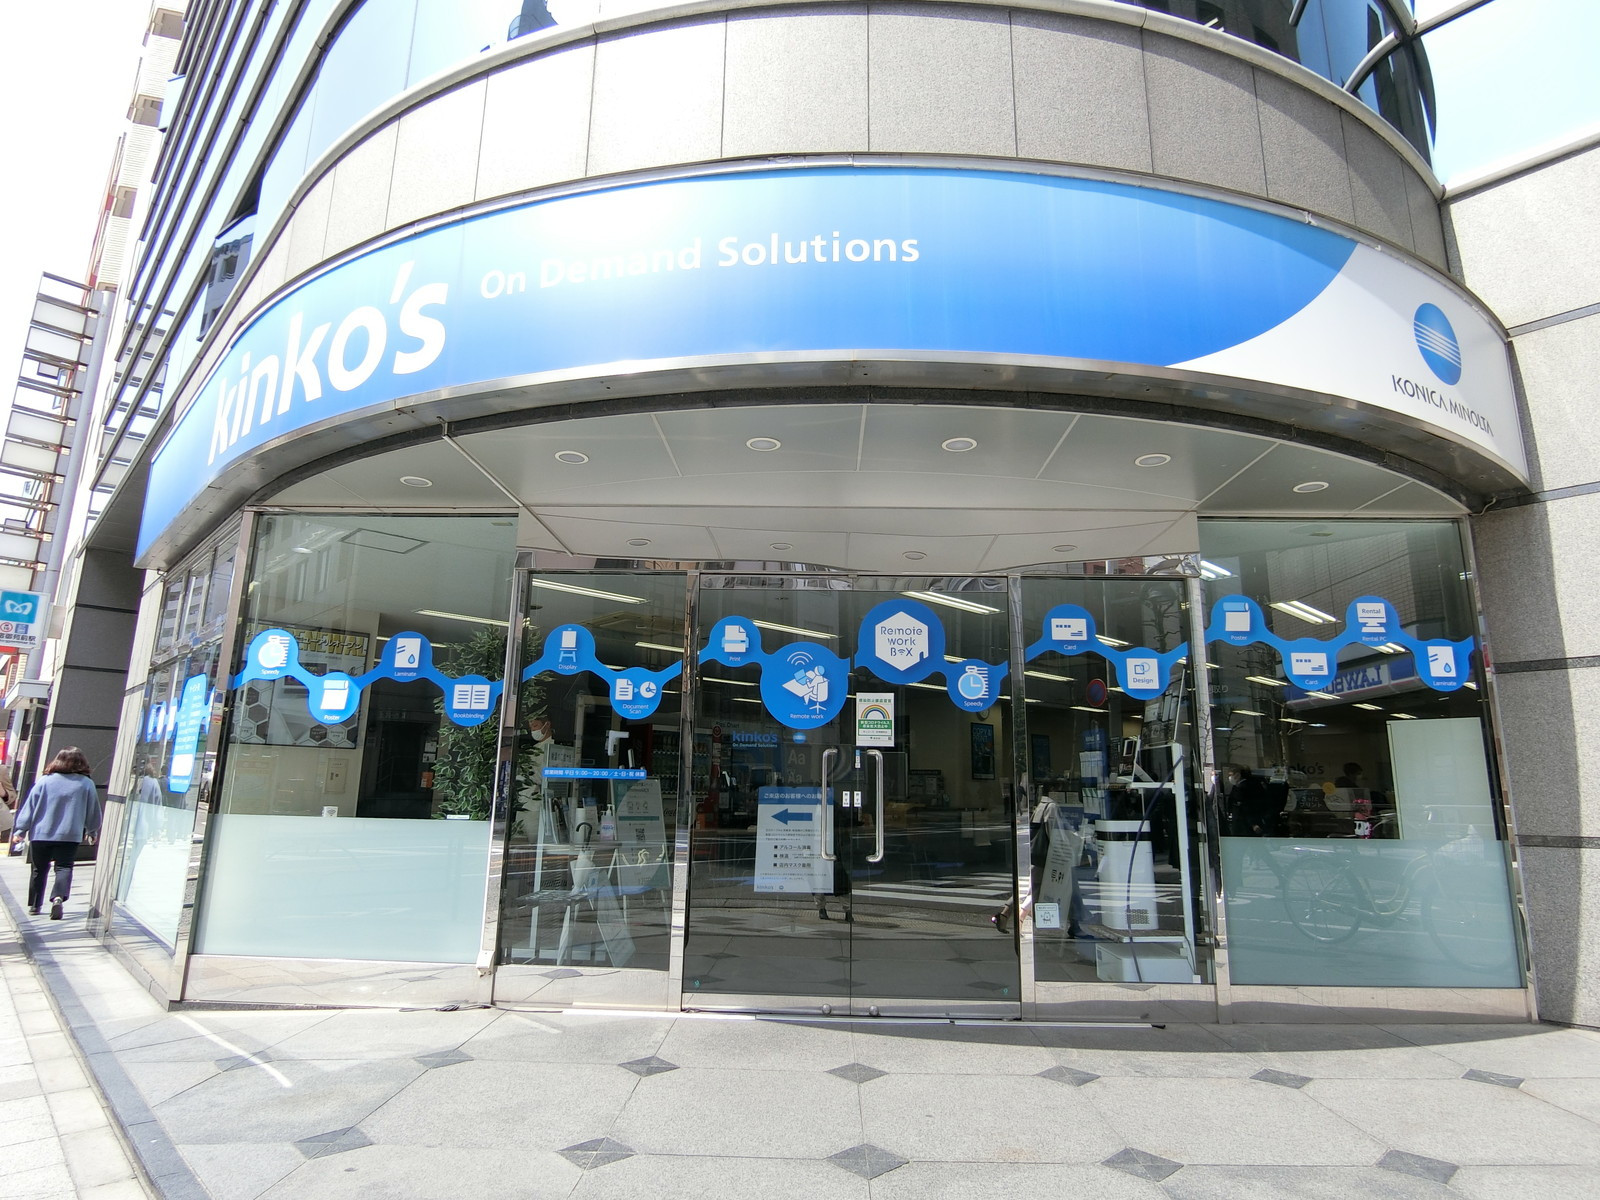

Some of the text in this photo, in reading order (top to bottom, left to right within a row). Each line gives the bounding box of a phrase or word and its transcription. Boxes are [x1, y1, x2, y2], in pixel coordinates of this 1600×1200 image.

[480, 231, 920, 299] On Demand Solutions
[207, 259, 449, 466] kinko's
[1392, 374, 1494, 437] KONICA MINOLTA
[880, 626, 923, 636] Remote
[887, 637, 916, 646] work
[261, 668, 280, 676] Speedy
[1132, 677, 1154, 685] Design
[453, 712, 485, 720] Bookbinding
[732, 730, 778, 743] kinko's
